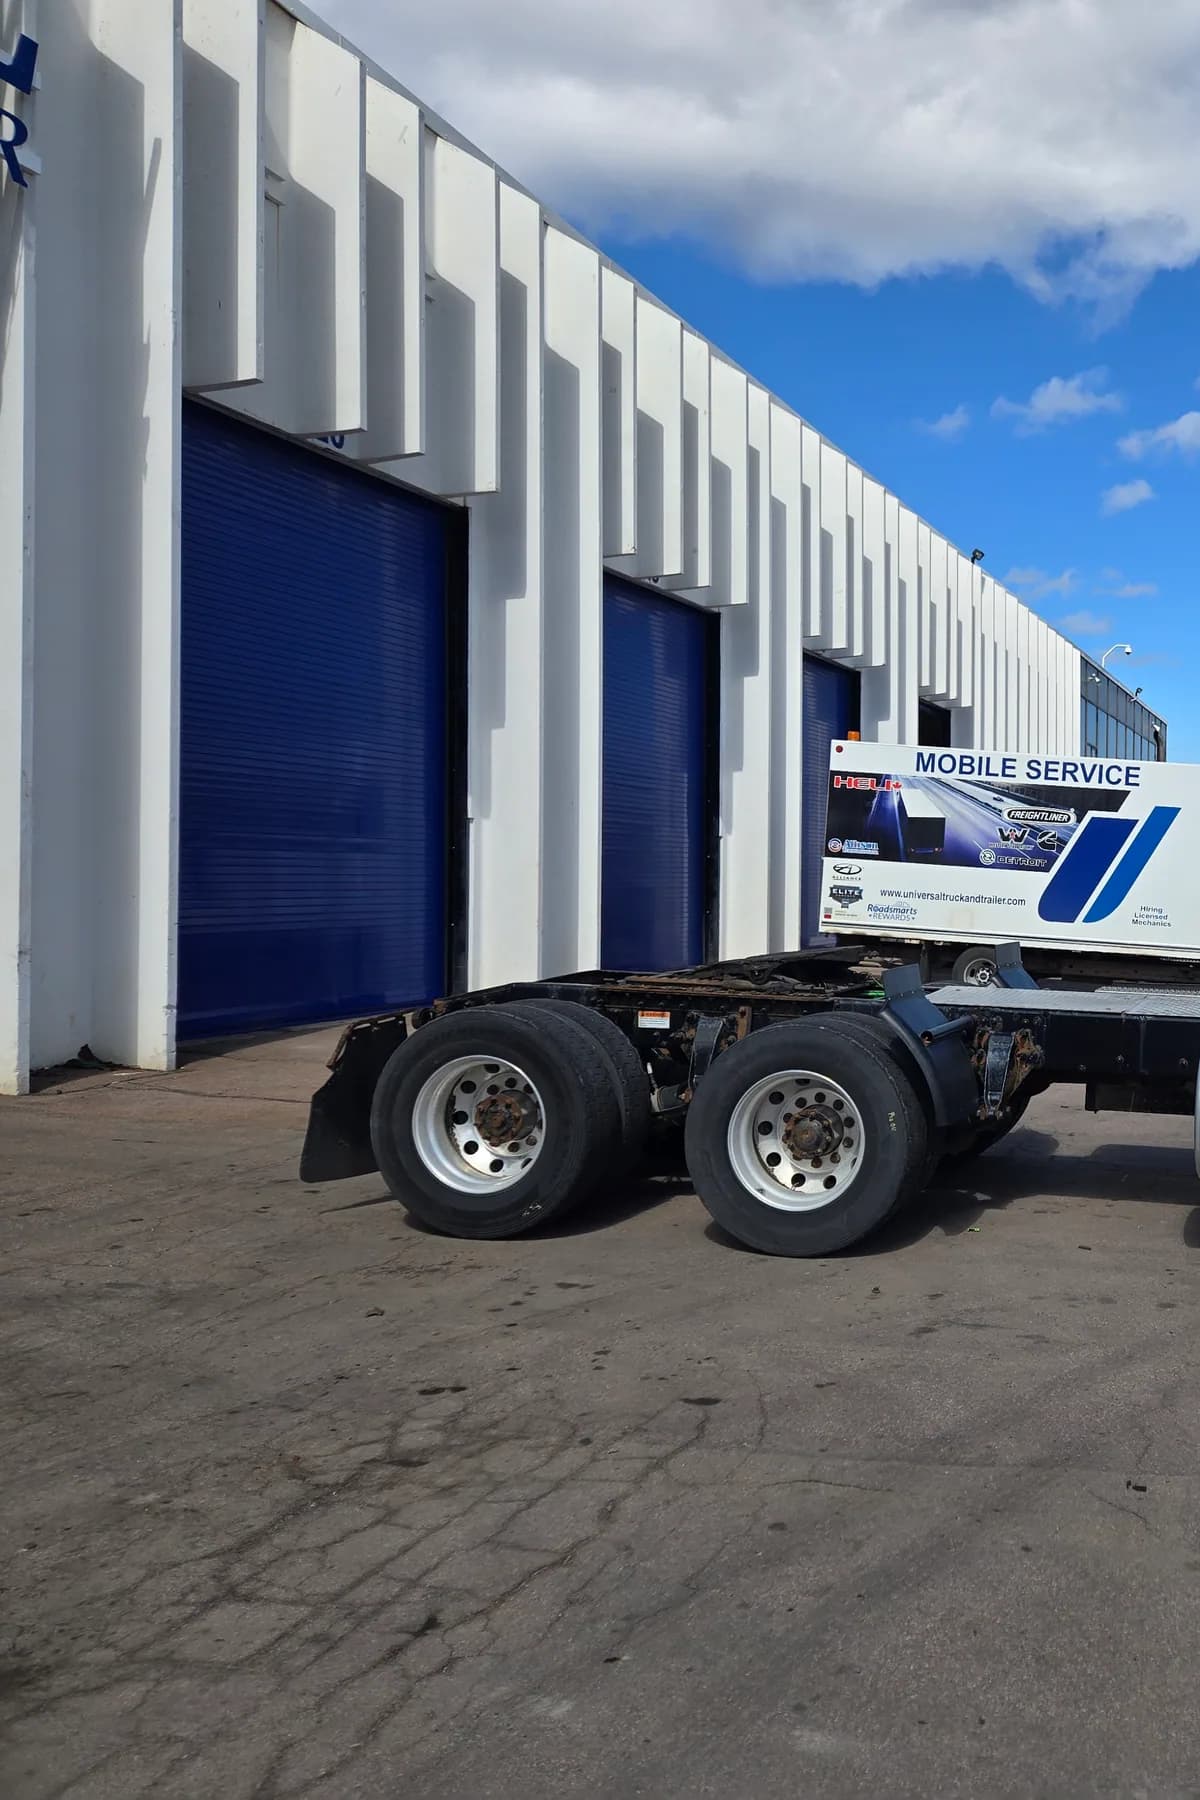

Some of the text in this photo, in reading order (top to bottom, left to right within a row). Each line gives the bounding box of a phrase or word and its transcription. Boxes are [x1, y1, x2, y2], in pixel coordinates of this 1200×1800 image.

[916, 751, 1141, 787] MOBILE SERVICE
[1009, 809, 1069, 823] FREIGHTLINER
[997, 856, 1048, 867] DETROIT
[880, 889, 1026, 906] www.universaltruckandtrailer.com
[867, 903, 918, 915] Roadsmarts
[1140, 905, 1163, 914] Hiring
[873, 912, 911, 921] REWARDS
[1134, 912, 1168, 920] Licensed
[1132, 919, 1171, 927] Mechanics
